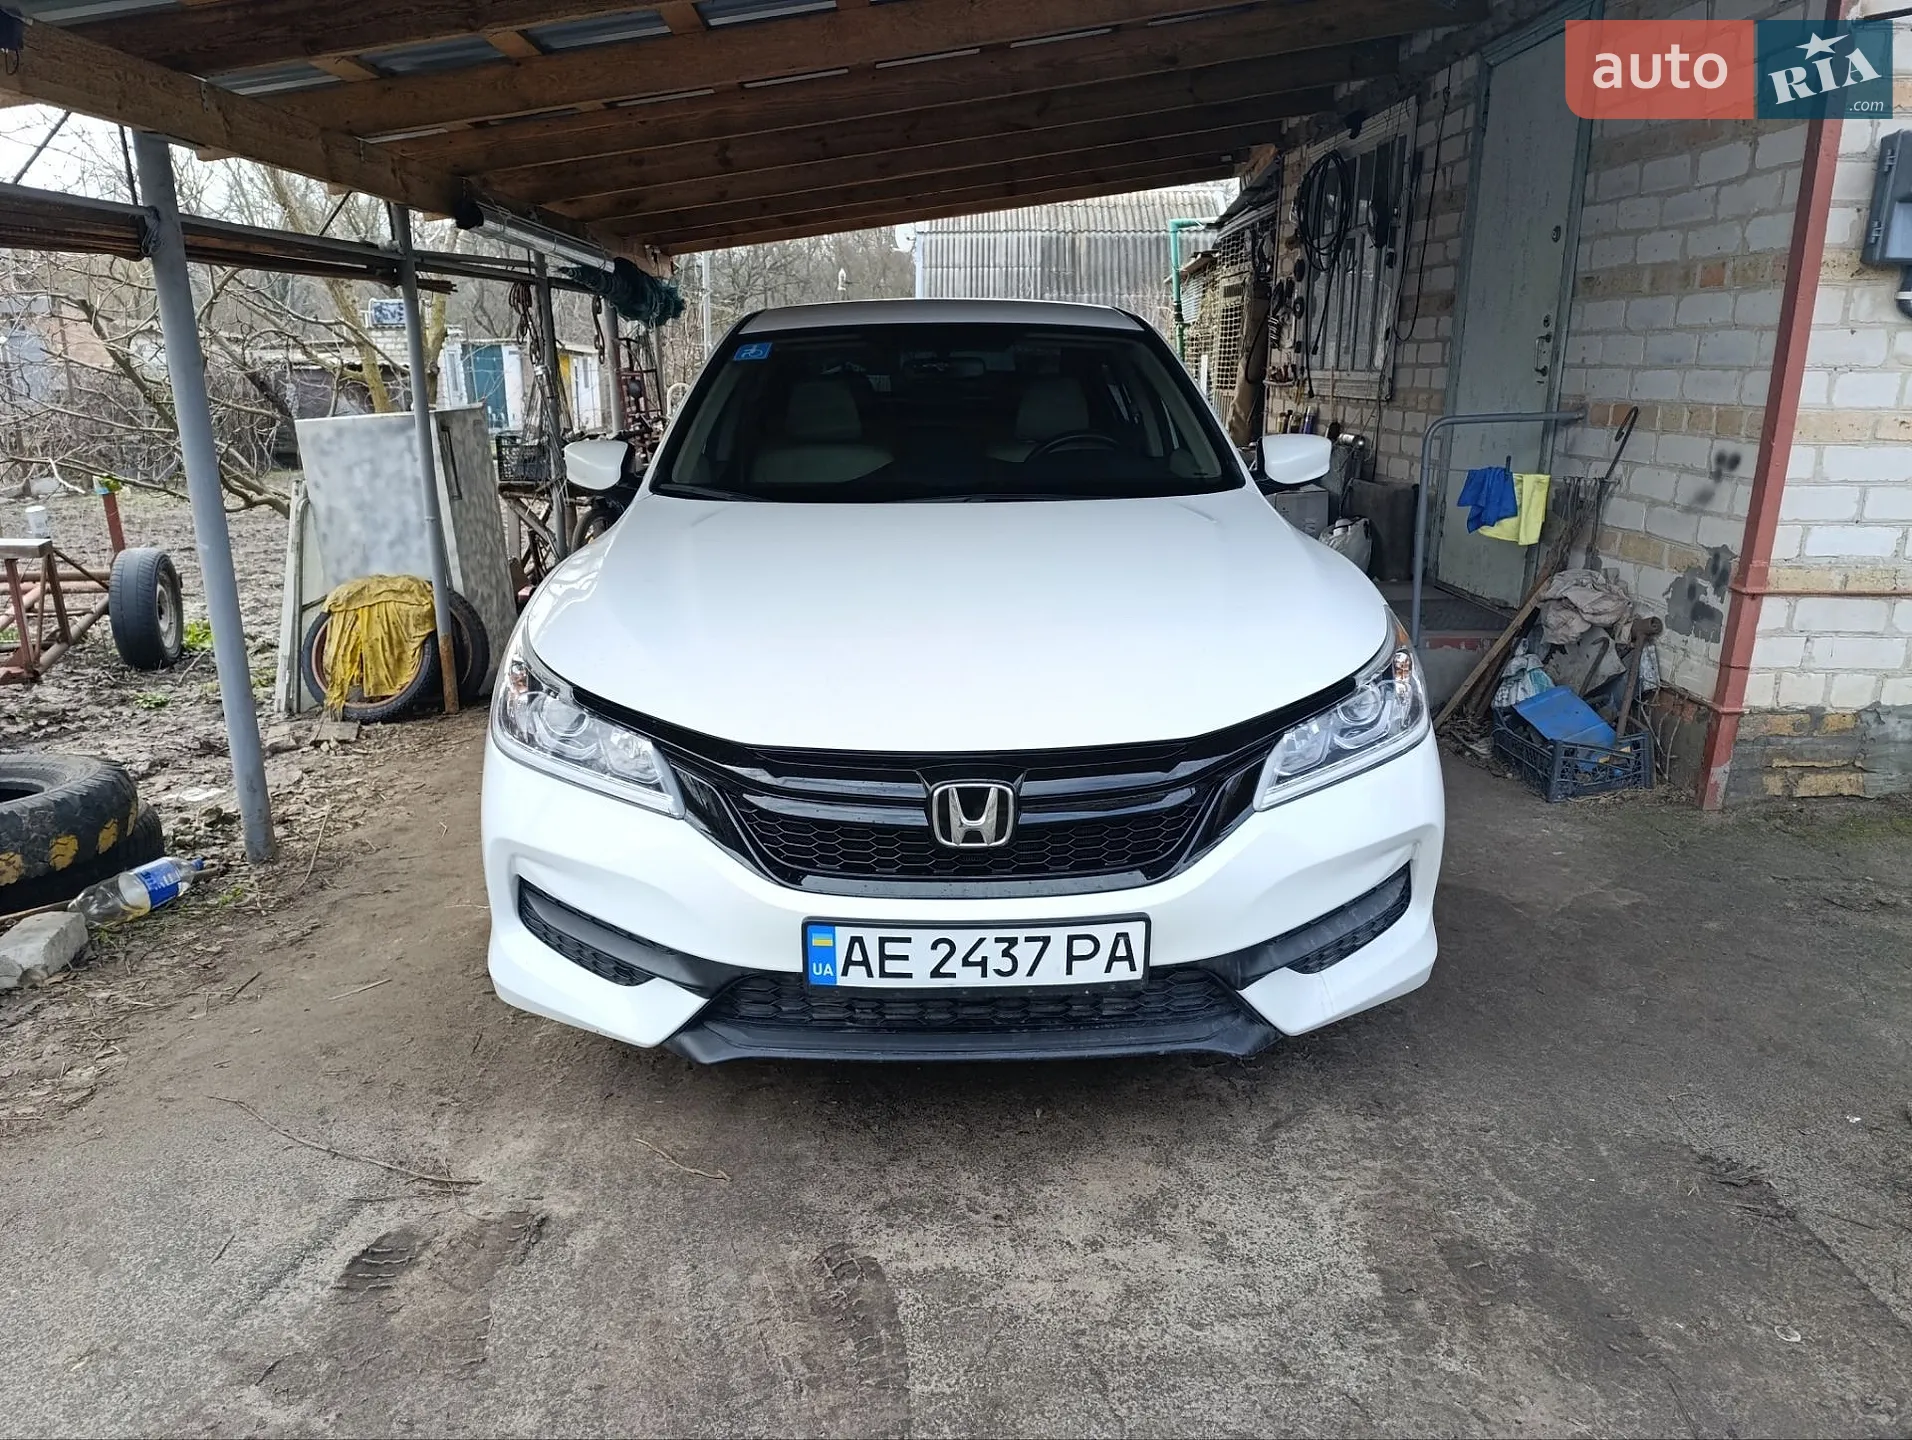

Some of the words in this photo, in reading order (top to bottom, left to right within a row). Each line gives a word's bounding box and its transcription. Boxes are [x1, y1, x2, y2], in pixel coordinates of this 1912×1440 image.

[812, 962, 835, 977] UA
[840, 935, 913, 979] AE
[930, 935, 1051, 979] 2437
[1065, 931, 1137, 976] PA
